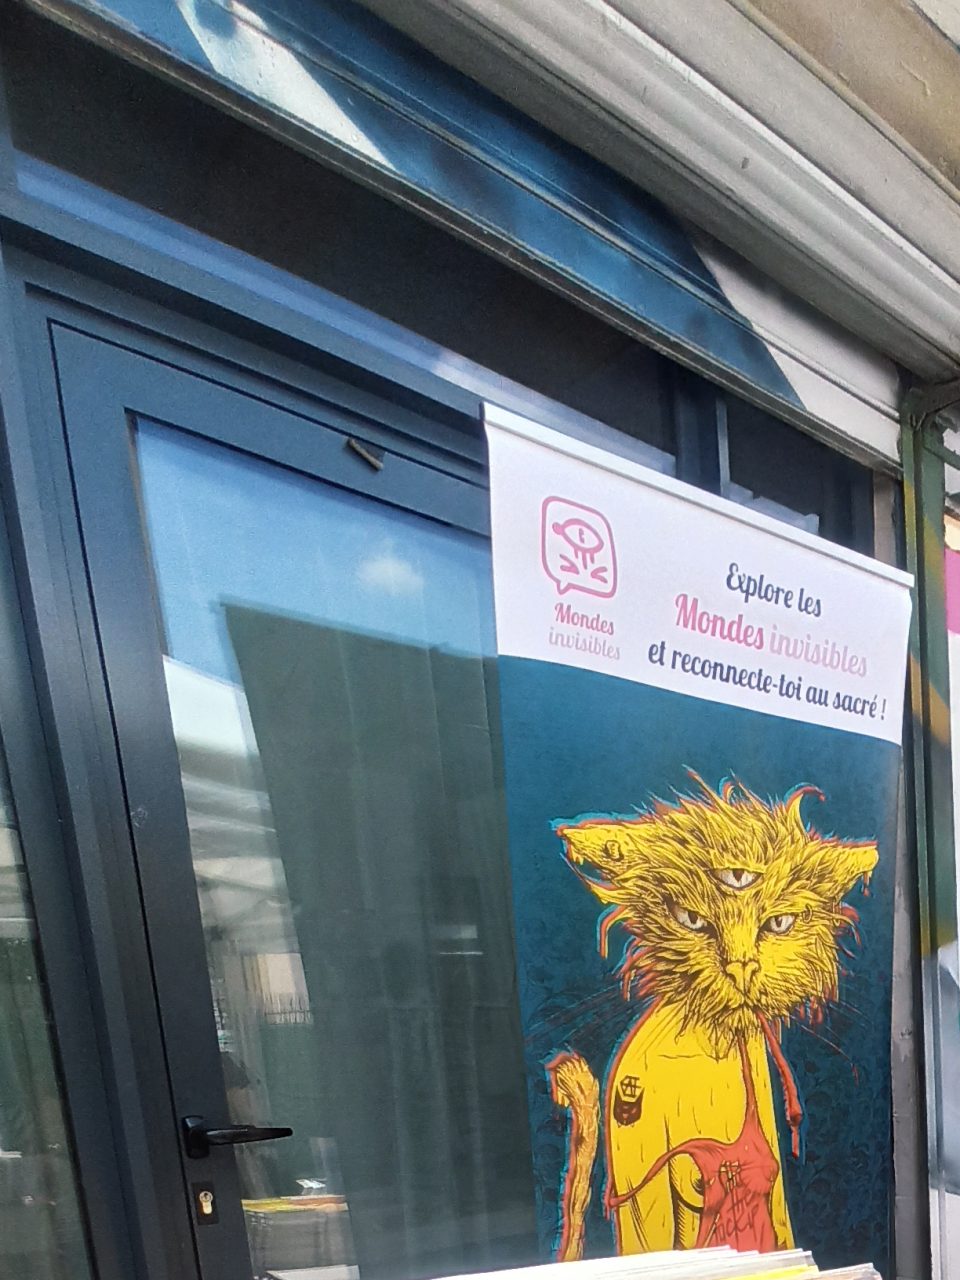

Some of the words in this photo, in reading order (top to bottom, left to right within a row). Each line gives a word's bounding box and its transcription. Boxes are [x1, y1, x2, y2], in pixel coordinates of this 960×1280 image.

[726, 562, 794, 609] Explore
[798, 588, 822, 617] les
[549, 626, 621, 660] invisibles
[554, 602, 615, 636] Mondes
[675, 593, 764, 650] Mondes
[770, 624, 867, 677] invisibles
[648, 641, 666, 666] et
[671, 649, 802, 701] reconnecte-toi
[806, 685, 828, 707] au
